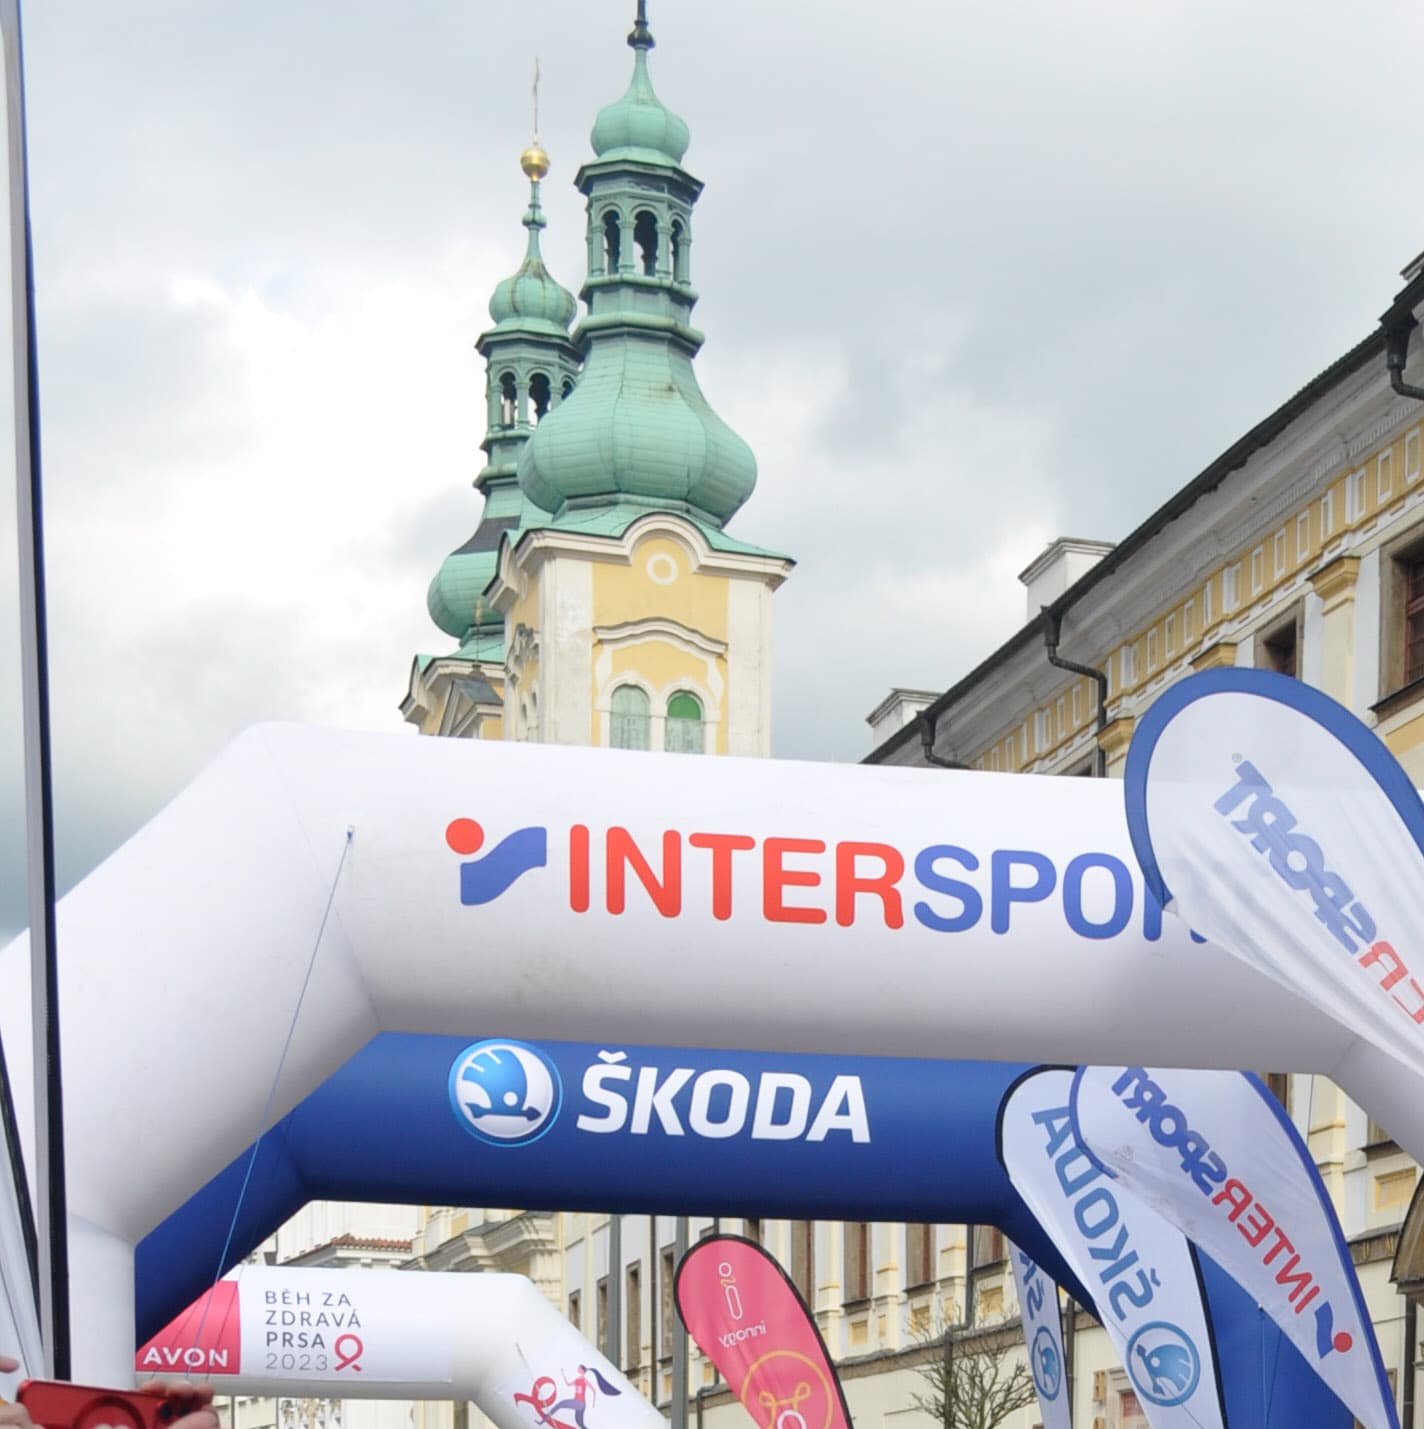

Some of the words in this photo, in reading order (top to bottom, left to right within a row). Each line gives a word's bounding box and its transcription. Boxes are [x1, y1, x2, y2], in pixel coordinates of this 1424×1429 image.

[569, 823, 1208, 942] INTERSPO
[577, 1050, 870, 1144] ŠKODA
[265, 1289, 311, 1306] BĚH
[323, 1291, 351, 1307] ZA
[265, 1309, 361, 1328] ZDRAVÁ
[266, 1331, 326, 1349] PRSA
[142, 1346, 229, 1368] AVON
[265, 1352, 328, 1371] 2023
